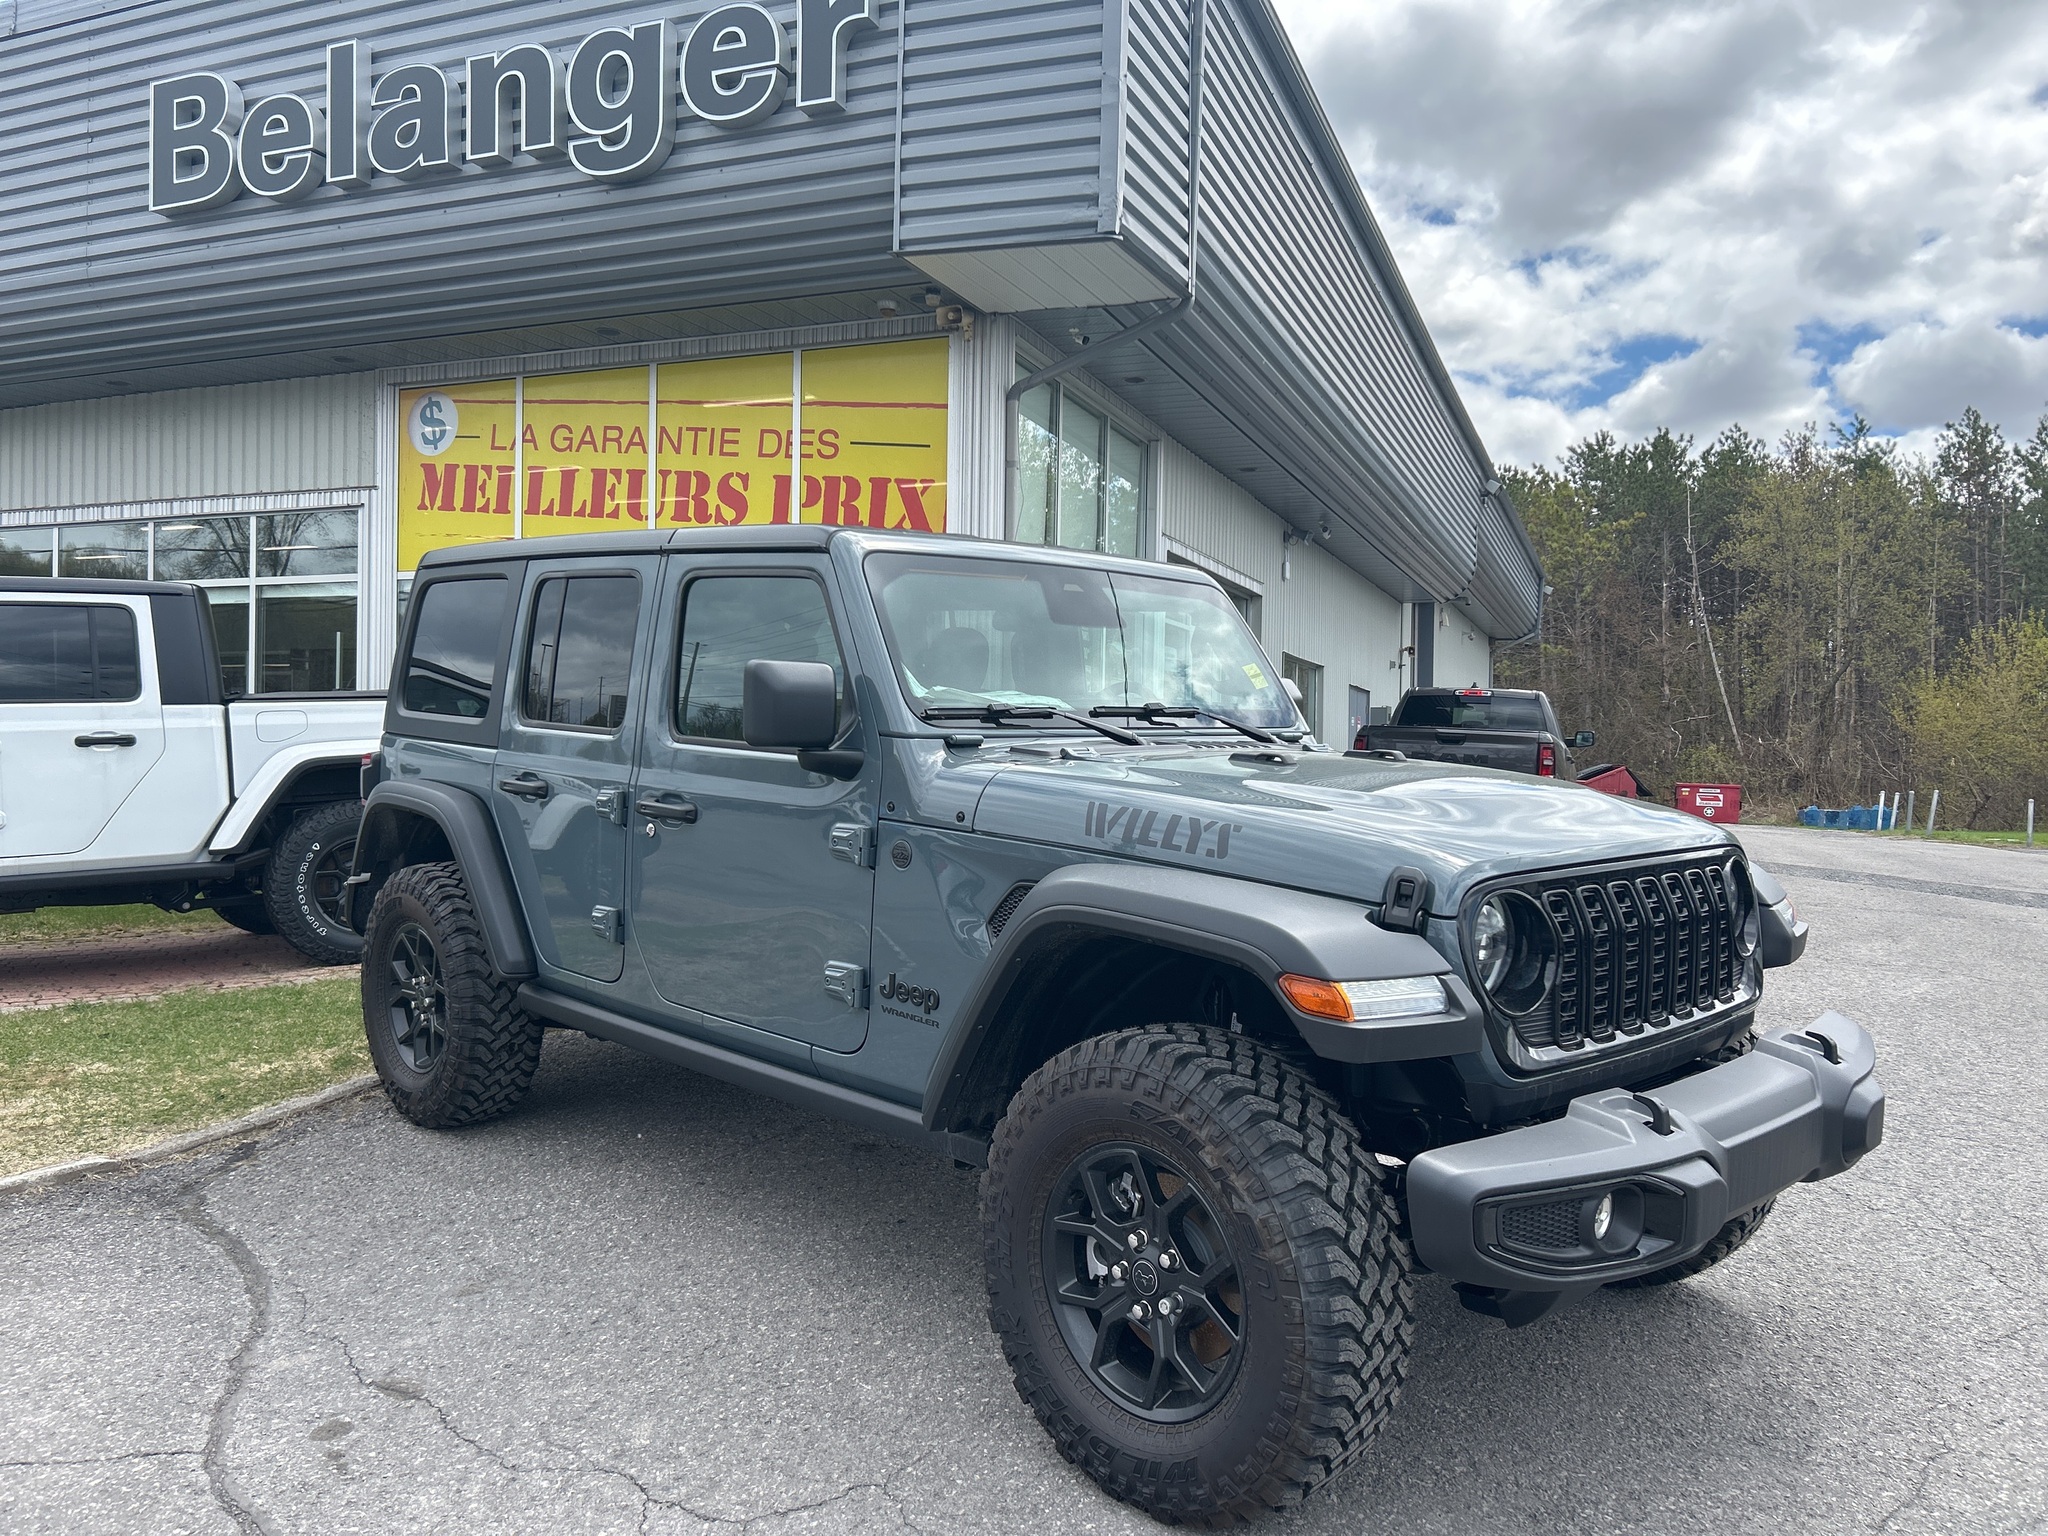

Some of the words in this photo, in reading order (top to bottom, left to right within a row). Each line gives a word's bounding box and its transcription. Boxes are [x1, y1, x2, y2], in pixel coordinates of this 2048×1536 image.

[149, 0, 880, 216] Belanger
[419, 396, 447, 451] $
[490, 423, 539, 451] LA
[550, 424, 741, 458] GARANTIE
[757, 428, 840, 460] DES
[417, 462, 750, 526] MEILLEURS
[769, 473, 937, 533] PRIX
[1085, 801, 1243, 860] WILLYS
[880, 972, 940, 1015] Jeep
[881, 1004, 940, 1029] WRANGLER
